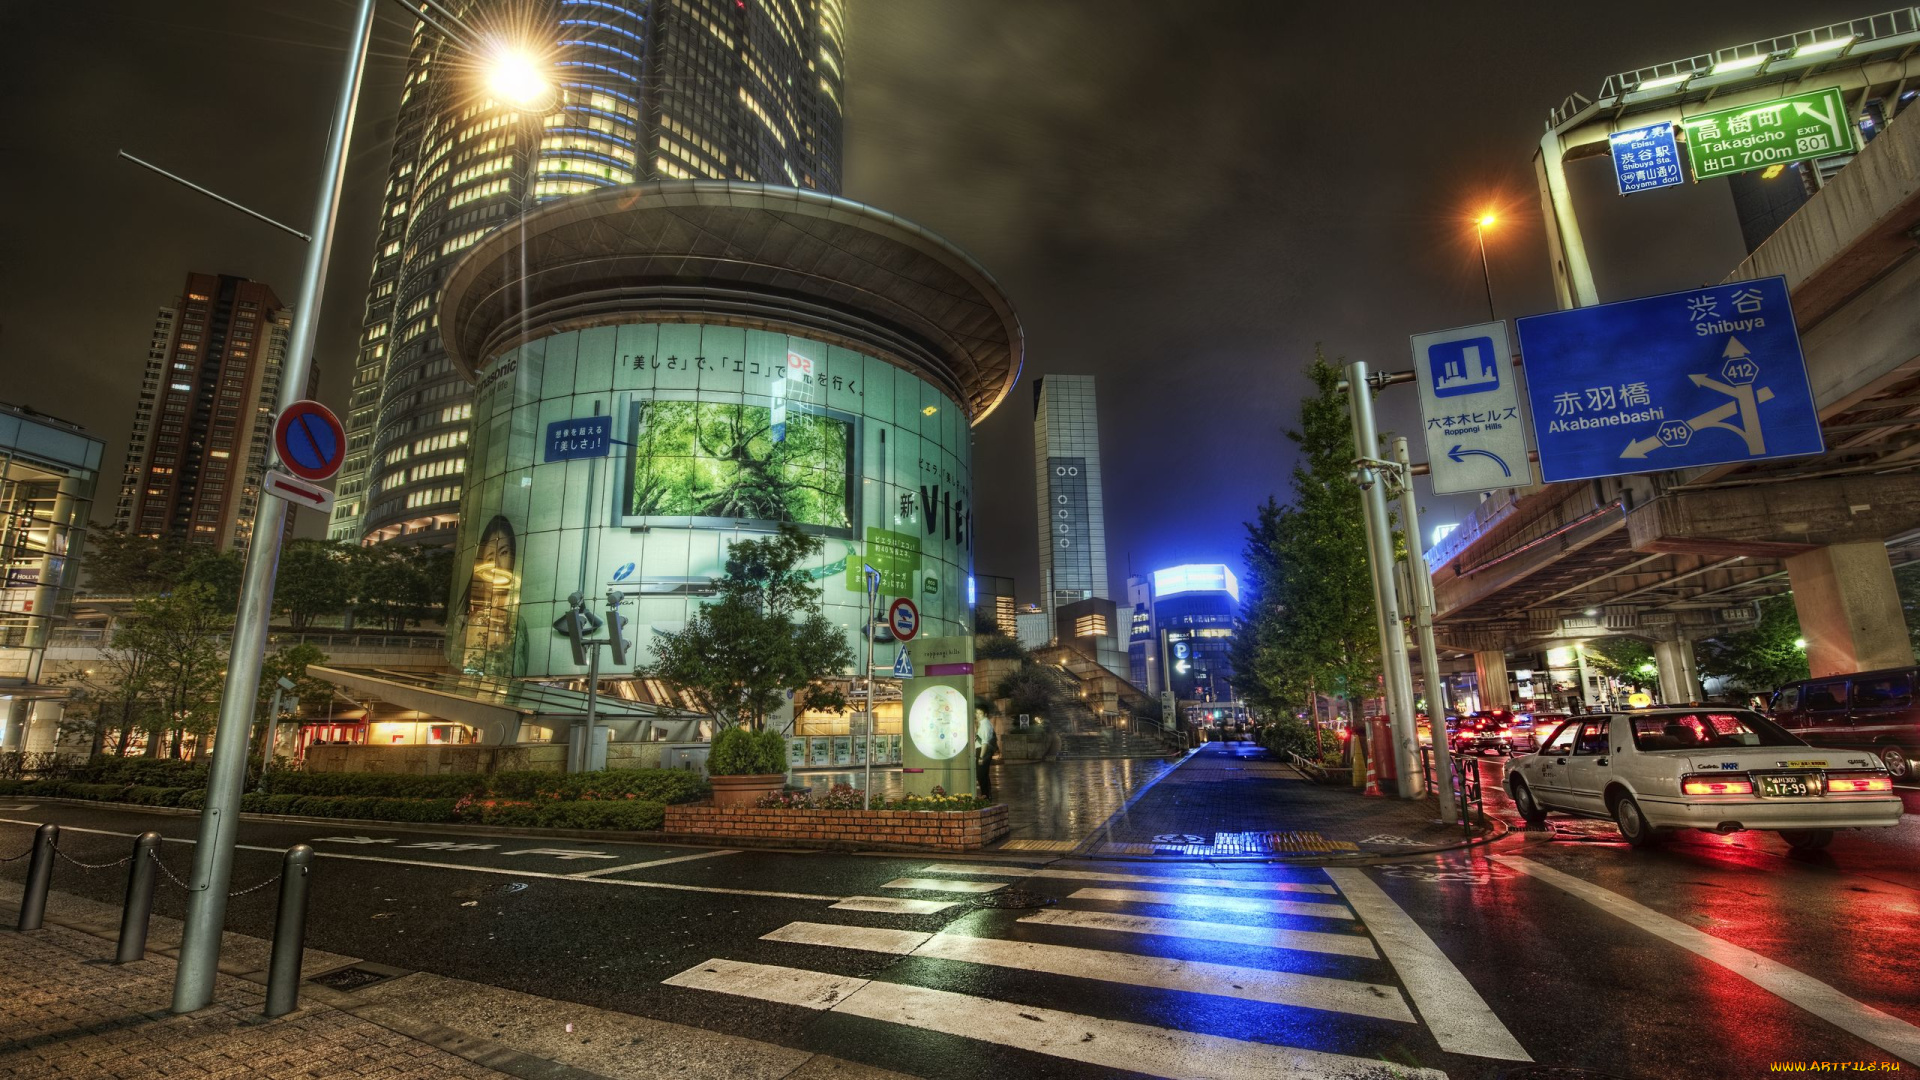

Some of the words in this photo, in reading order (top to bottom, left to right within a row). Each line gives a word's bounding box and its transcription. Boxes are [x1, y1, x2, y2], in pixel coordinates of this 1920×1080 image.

[1697, 107, 1783, 142] 高樹町
[1797, 124, 1821, 136] EXIT
[1631, 140, 1655, 150] Ebisu
[1701, 130, 1786, 153] Takagicho
[1797, 135, 1829, 152] 301
[1621, 145, 1671, 165] 渋谷駅
[1703, 155, 1736, 172] 出口
[1740, 146, 1793, 165] 700m
[1623, 160, 1654, 171] Shibuya
[1656, 157, 1672, 165] Sta.
[1635, 164, 1678, 182] 青山通り
[1625, 180, 1657, 191] Aoyama
[1662, 175, 1678, 184] dori
[1687, 288, 1764, 321] 渋谷
[1695, 317, 1766, 337] Shibuya
[1727, 363, 1754, 379] 412
[1553, 381, 1651, 417] 赤羽橋
[1427, 406, 1518, 430] 六本木ヒルズ
[1548, 406, 1665, 434] Akabanebashi
[555, 426, 602, 439] 想像を超える
[1444, 425, 1480, 436] Roppongi
[1485, 422, 1503, 431] Hills
[1662, 425, 1688, 442] 319
[1774, 783, 1807, 794] 17-99
